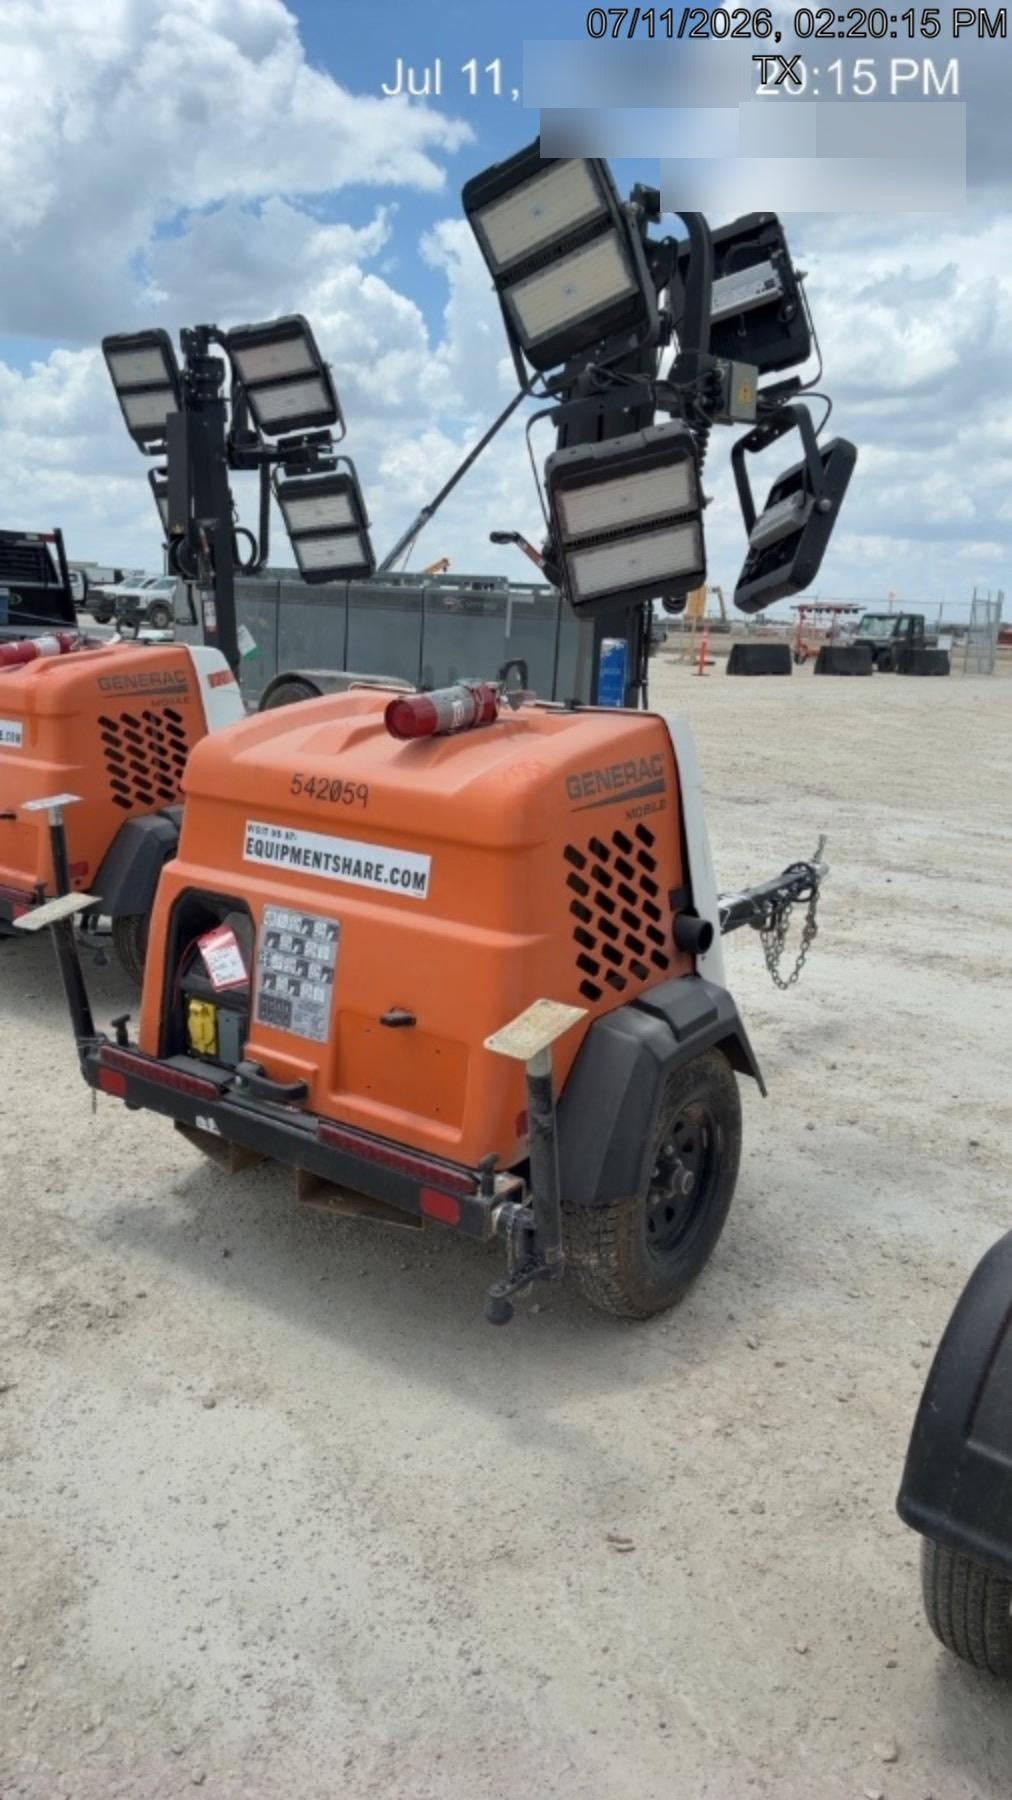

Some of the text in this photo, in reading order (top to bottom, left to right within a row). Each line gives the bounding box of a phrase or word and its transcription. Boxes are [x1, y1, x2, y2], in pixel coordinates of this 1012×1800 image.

[98, 669, 188, 691] GENERAC
[291, 773, 369, 808] 542059
[565, 753, 664, 800] GENERAC
[246, 837, 426, 891] EQUIPMENTSHARE.COM
